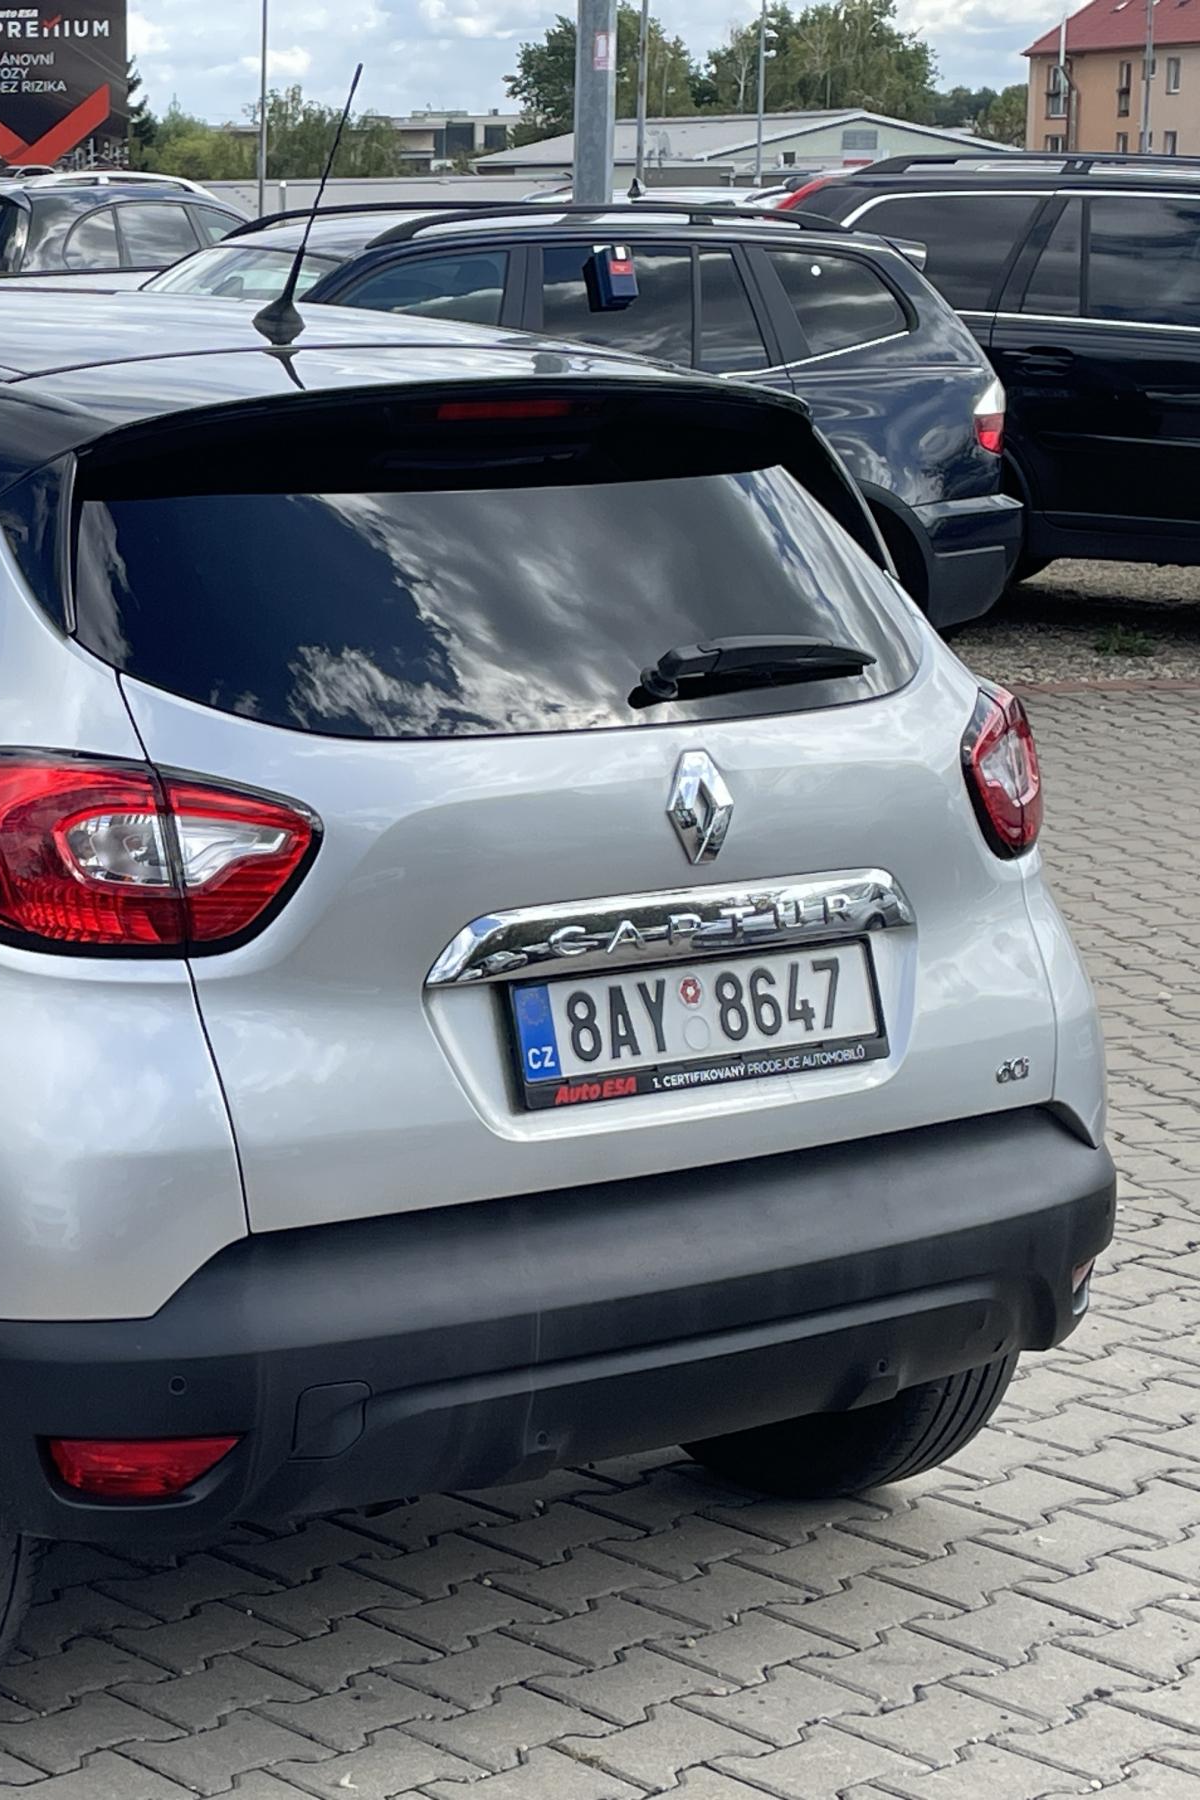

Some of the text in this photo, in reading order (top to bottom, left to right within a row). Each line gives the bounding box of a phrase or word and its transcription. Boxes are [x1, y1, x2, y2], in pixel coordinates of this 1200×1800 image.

[18, 9, 39, 18] ESA
[22, 80, 67, 92] RIZIKA
[550, 895, 852, 953] CAPTUR
[567, 957, 840, 1062] 8AY 8647
[527, 1047, 556, 1070] CZ
[663, 1063, 746, 1087] CERTIFIKOVANÝ
[747, 1056, 800, 1074] PRODEJCE
[802, 1044, 865, 1067] AUTOMOBILŮ
[555, 1076, 638, 1105] Auto ESA
